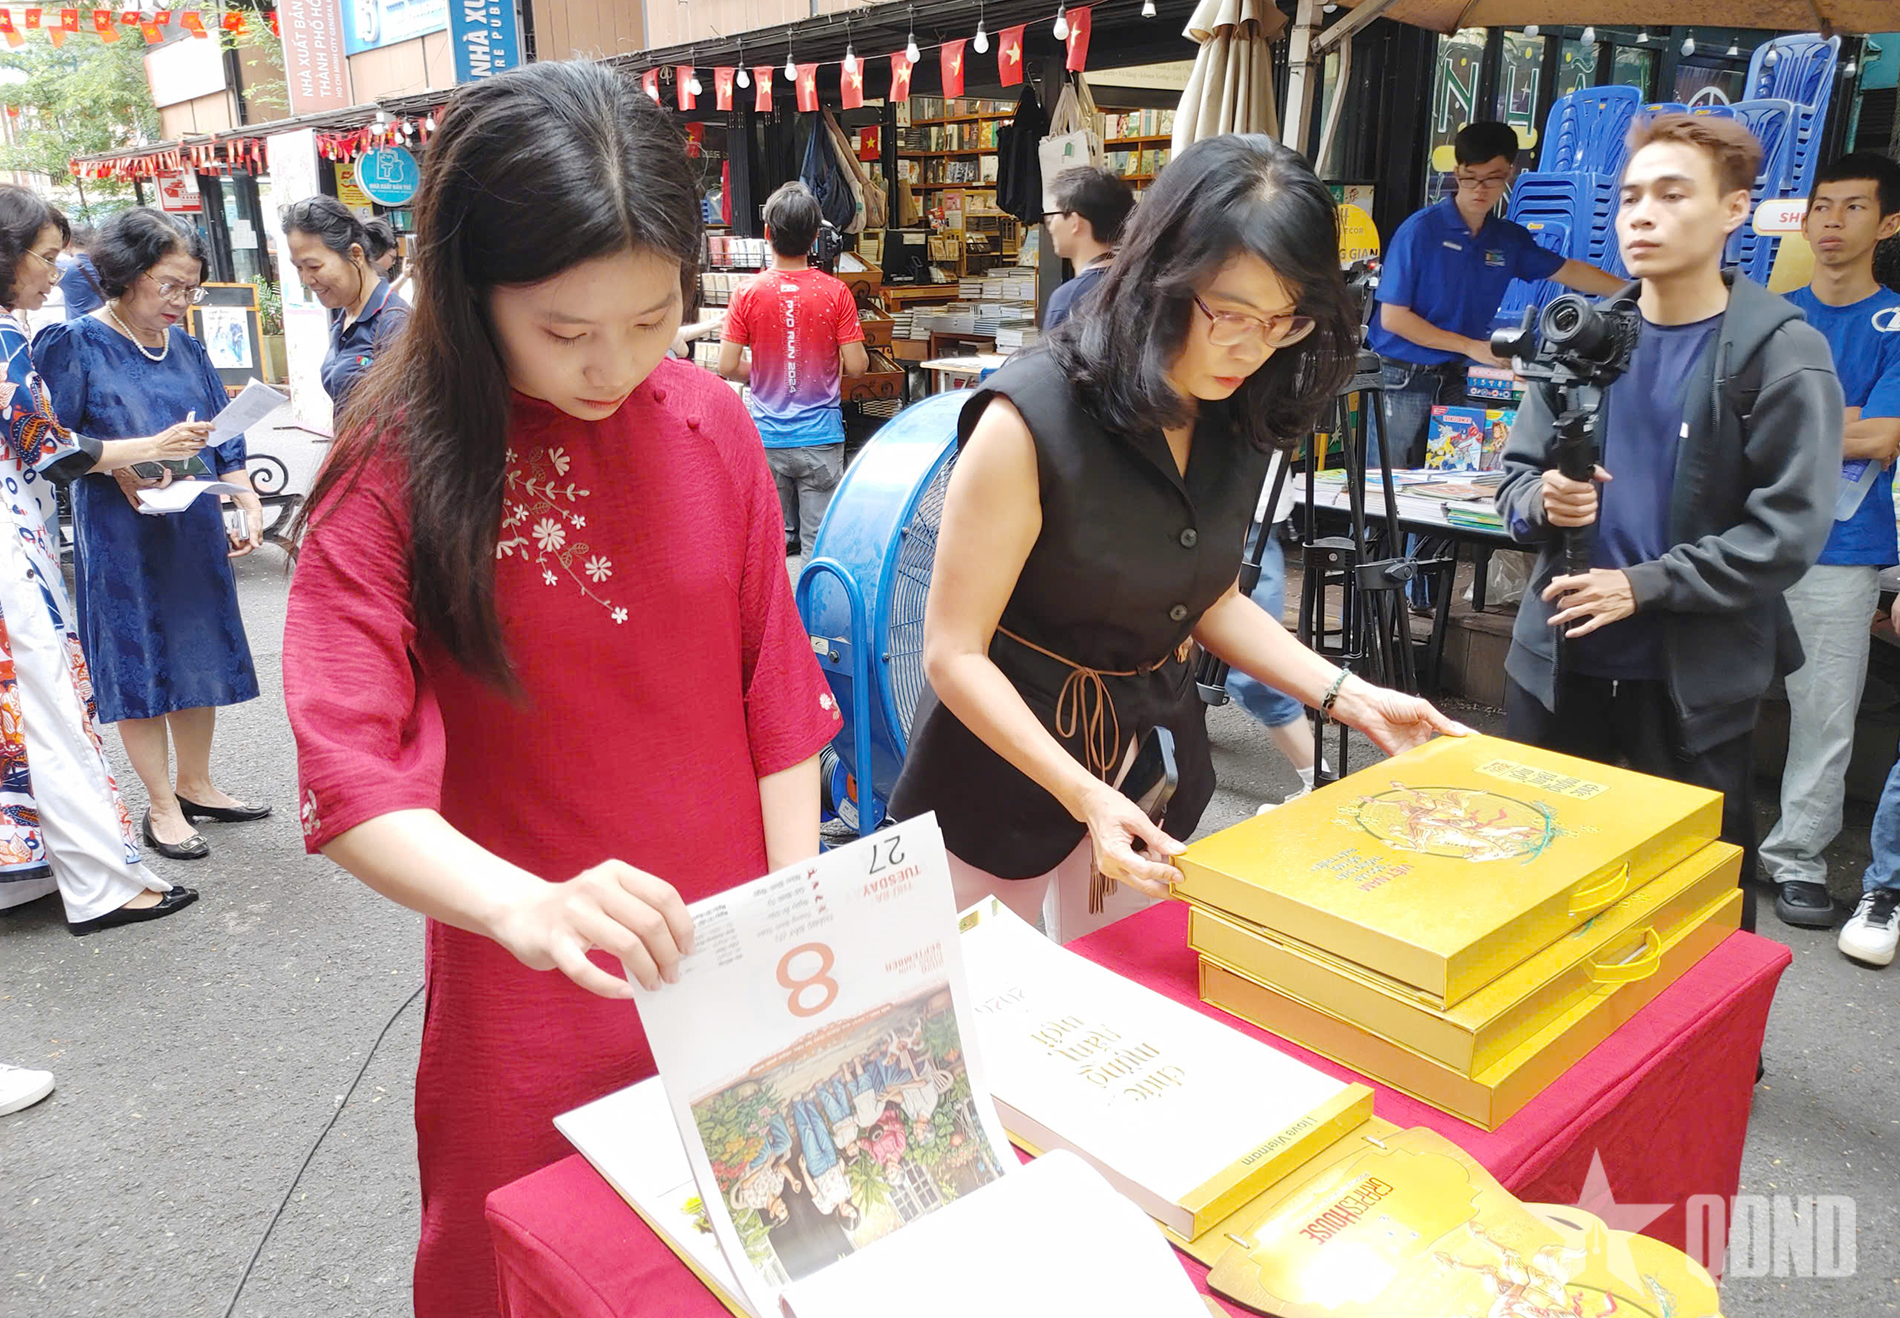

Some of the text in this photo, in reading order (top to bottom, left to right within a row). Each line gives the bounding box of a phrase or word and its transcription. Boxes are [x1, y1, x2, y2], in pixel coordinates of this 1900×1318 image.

[307, 20, 325, 48] PHỐ
[326, 4, 336, 36] GENERAL
[288, 0, 314, 97] NHÀ XUẤT BẢN
[330, 38, 338, 52] CITY
[463, 30, 492, 77] NHÀ
[488, 0, 505, 75] RE PUB
[315, 52, 331, 97] THÀNH
[787, 331, 796, 359] RUN
[788, 362, 797, 393] 2024
[869, 835, 904, 874] 27
[863, 864, 921, 897] TUESDAY
[1358, 876, 1391, 892] NAM
[776, 942, 839, 1018] 8
[1286, 1118, 1316, 1137] love
[1241, 1135, 1289, 1166] Vietnam
